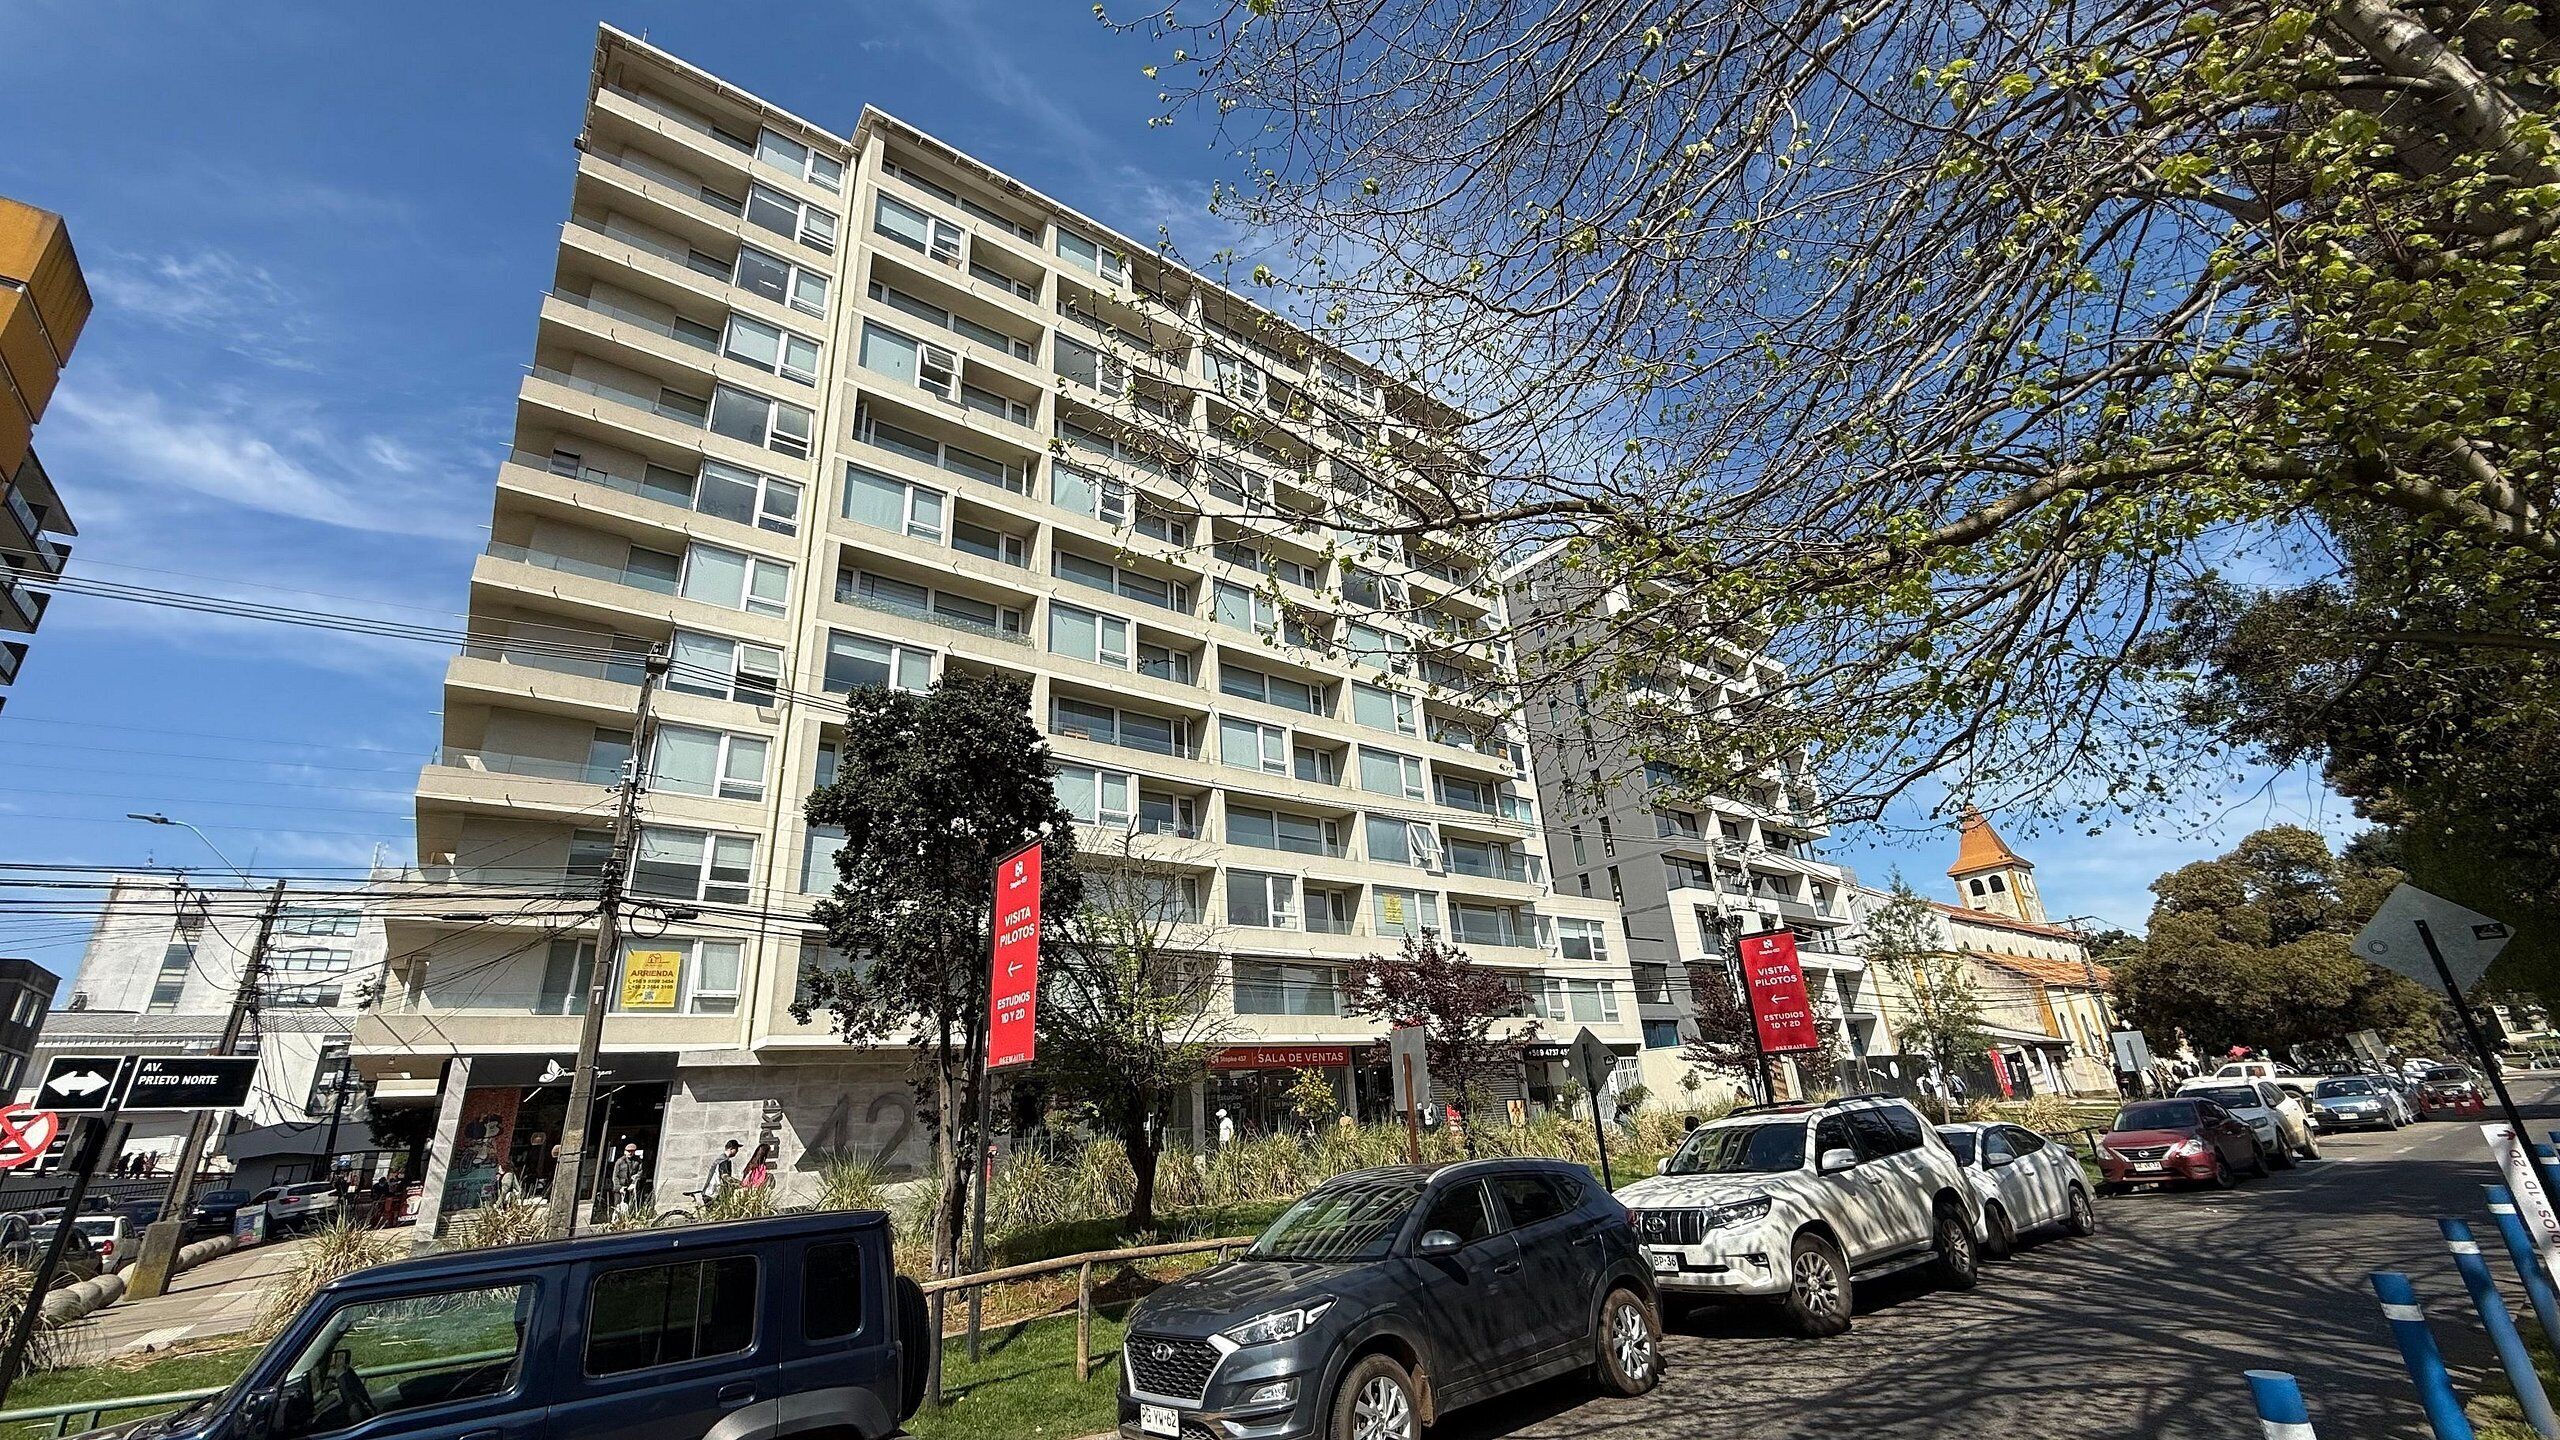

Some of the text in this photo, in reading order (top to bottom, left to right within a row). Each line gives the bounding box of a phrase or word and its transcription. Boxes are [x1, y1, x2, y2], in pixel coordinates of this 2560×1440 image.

[1004, 906, 1031, 927] VISITA
[999, 923, 1035, 948] PILOTOS
[1757, 965, 1790, 976] VISITA
[1755, 974, 1797, 987] PILOTOS
[997, 991, 1030, 1010] ESTUDIOS
[1010, 1010, 1016, 1022] Y
[1764, 1010, 1804, 1021] ESTUDIOS
[1258, 1052, 1344, 1063] SALA DE VENTAS
[143, 1062, 163, 1072] AV.
[138, 1075, 219, 1085] PRIETO NORTE
[2510, 1149, 2526, 1168] 2D
[2524, 1180, 2540, 1197] 1D
